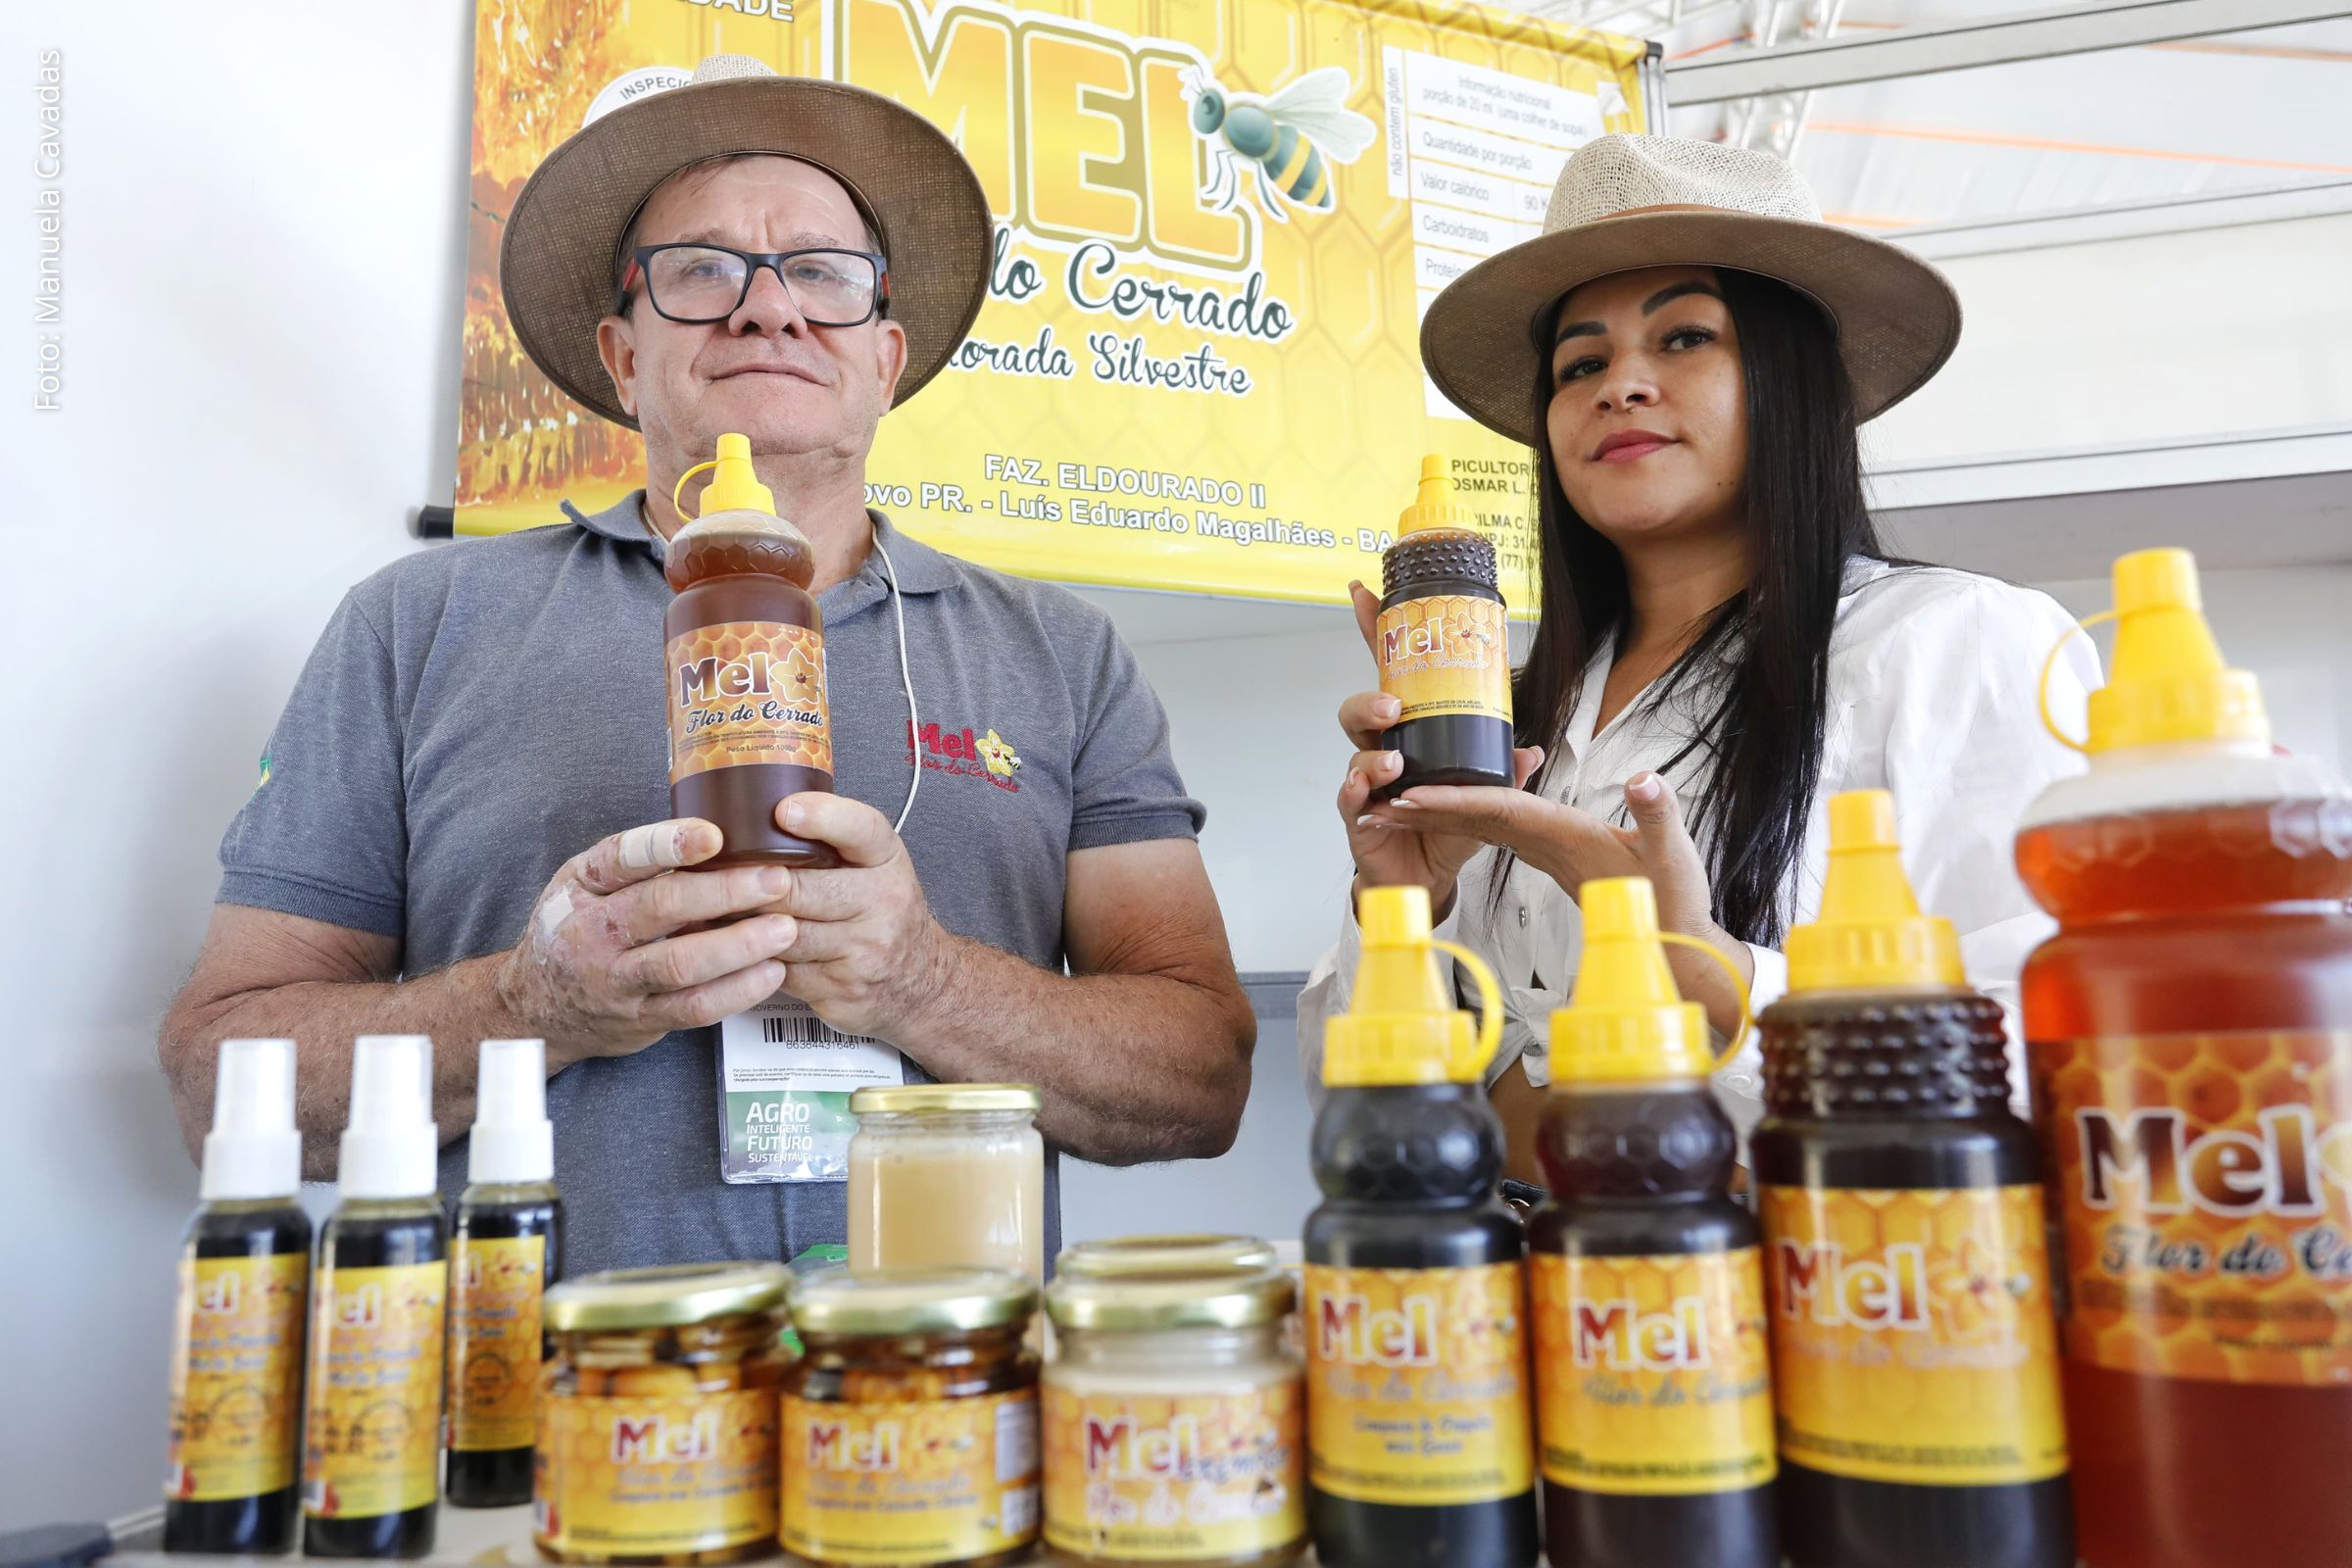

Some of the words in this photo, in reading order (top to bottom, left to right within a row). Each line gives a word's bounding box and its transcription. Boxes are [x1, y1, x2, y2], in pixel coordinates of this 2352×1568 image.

[821, 0, 1261, 274] MEL
[1422, 130, 1480, 159] Quantidade
[1481, 147, 1497, 164] por
[1421, 171, 1448, 191] Valor
[1421, 214, 1491, 244] Carboidratos
[1067, 242, 1294, 340] Cerrado
[949, 327, 1075, 378] orada
[1089, 334, 1252, 395] Silvestre
[984, 453, 1051, 487] FAZ.
[1057, 462, 1244, 509] ELDOURADO
[1249, 483, 1267, 510] II
[919, 481, 974, 514] PR.
[999, 489, 1063, 522] Luís
[1069, 498, 1191, 534] Eduardo
[1195, 510, 1338, 547] Magalhães
[1384, 615, 1445, 666] Mel
[679, 651, 772, 709] Mel
[686, 708, 725, 734] Flor
[729, 703, 756, 723] do
[759, 700, 824, 729] Cerrado
[906, 719, 977, 761] Mel
[745, 1102, 811, 1125] AGRO
[746, 1123, 812, 1135] INTELIGENTE
[746, 1135, 813, 1152] FUTURO
[2075, 1102, 2327, 1219] Mel
[2217, 1228, 2288, 1277] do
[1777, 1236, 1933, 1331] Mel
[1316, 1290, 1439, 1368] Mel
[1572, 1296, 1711, 1372] Mel
[612, 1406, 723, 1464] Mel
[807, 1418, 901, 1472] Mel
[1083, 1414, 1200, 1481] Mel
